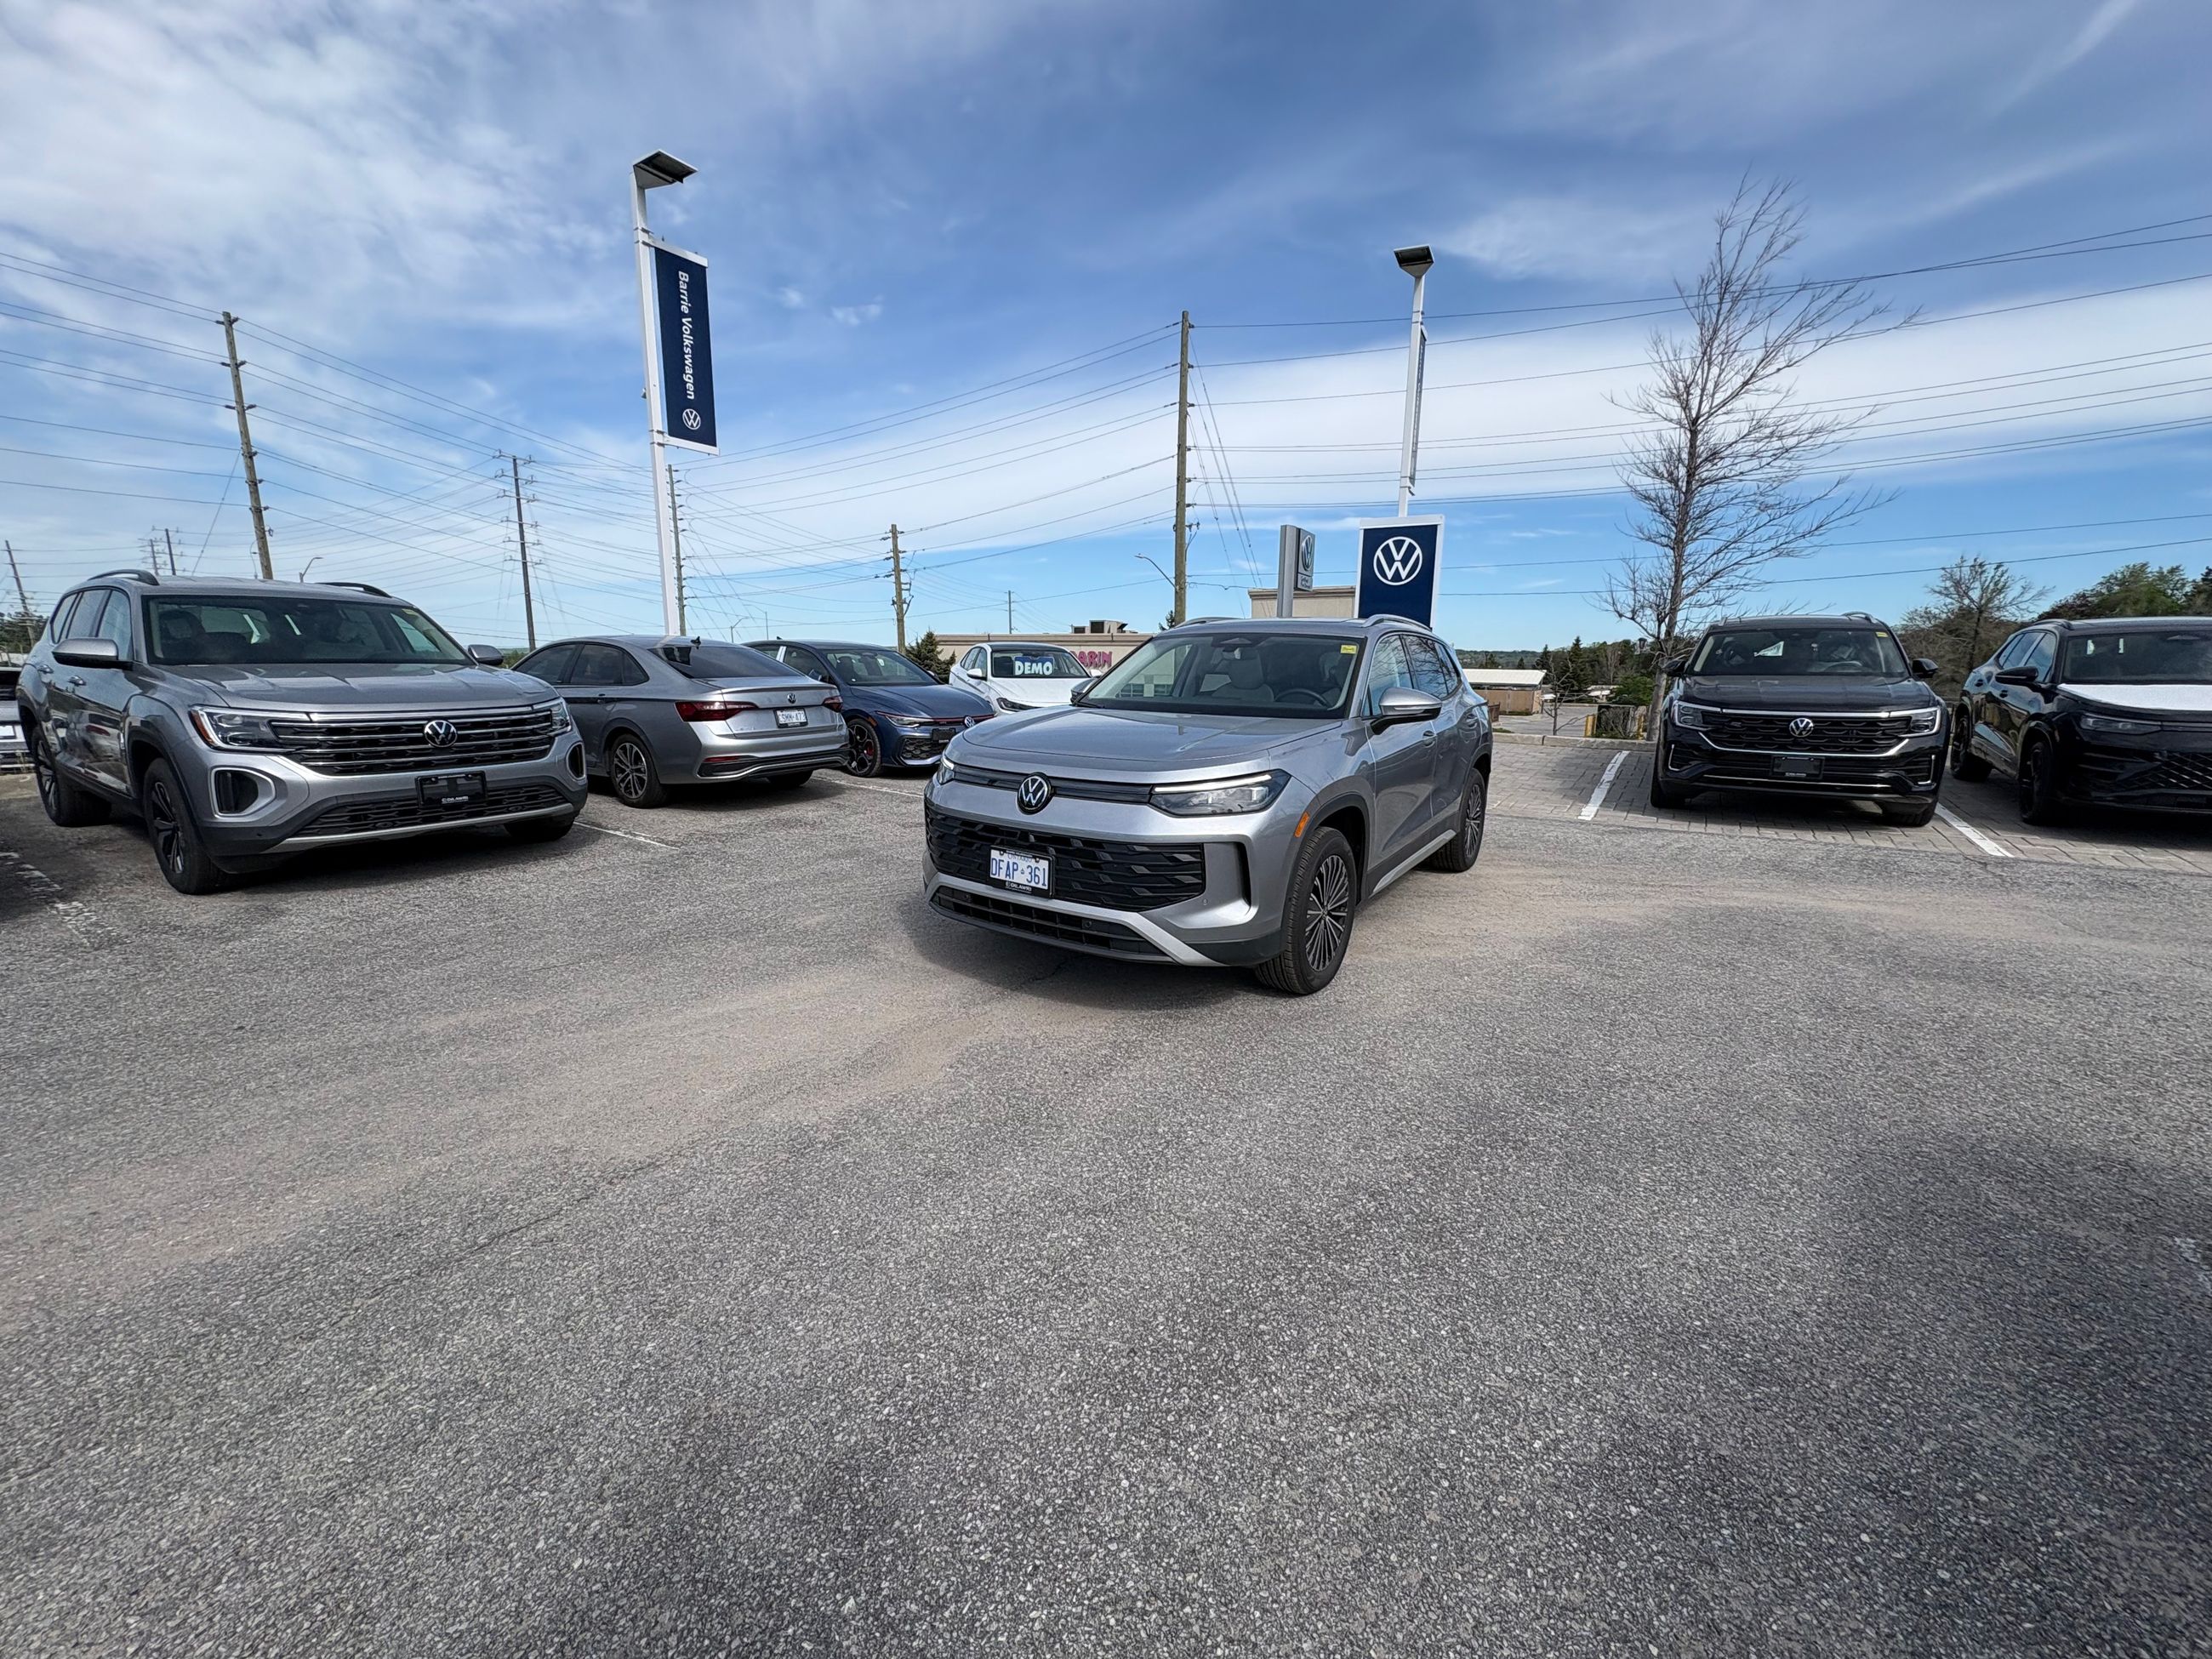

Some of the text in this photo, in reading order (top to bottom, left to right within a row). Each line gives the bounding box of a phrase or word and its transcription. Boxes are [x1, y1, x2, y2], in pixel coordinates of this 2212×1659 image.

[678, 271, 695, 400] Barrie Volkswagen
[1015, 661, 1052, 676] DEMO
